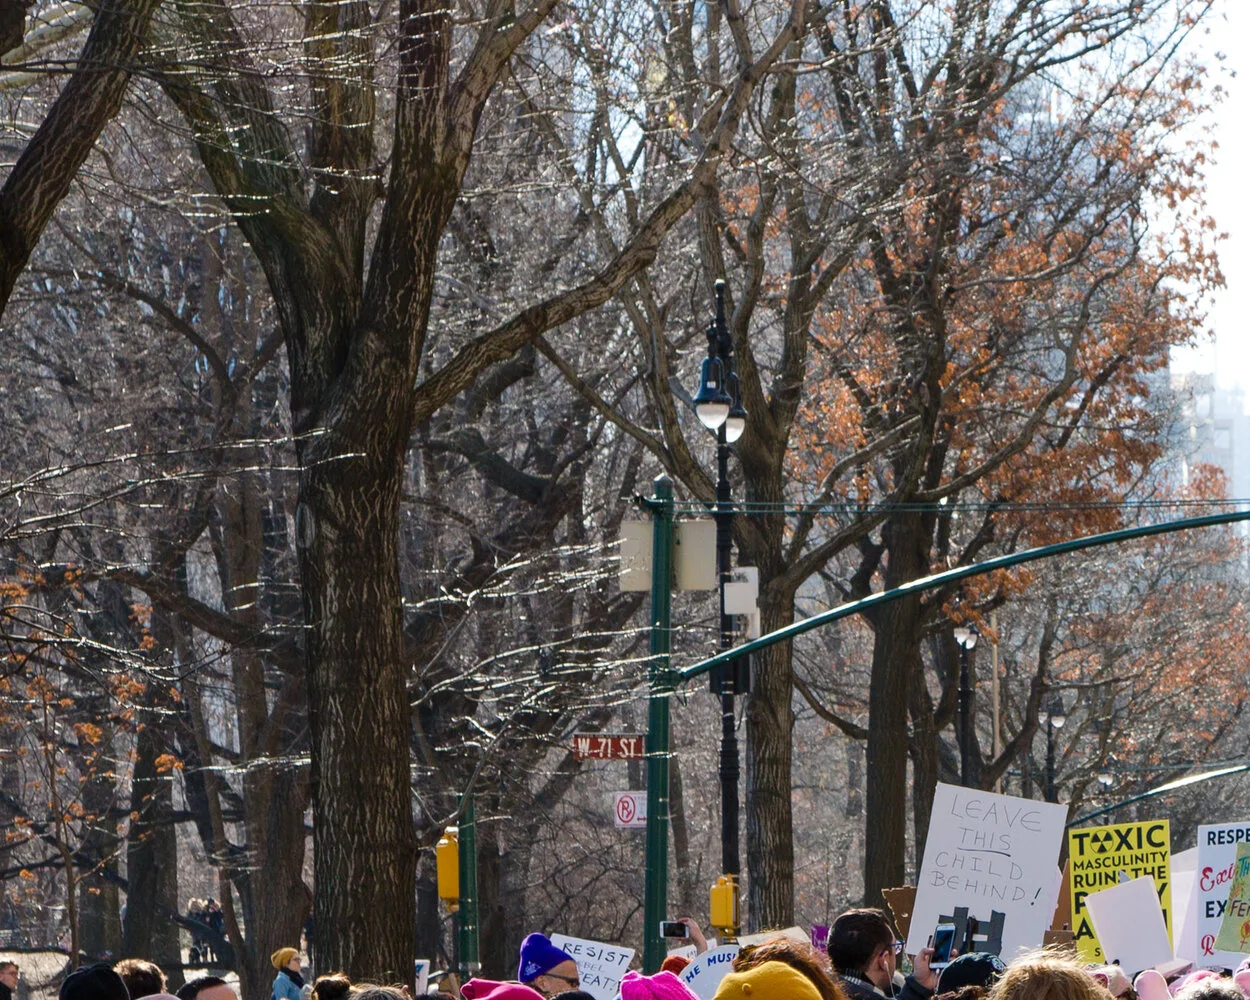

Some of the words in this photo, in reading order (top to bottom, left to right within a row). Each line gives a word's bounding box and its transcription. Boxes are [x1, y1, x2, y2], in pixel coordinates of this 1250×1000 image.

[577, 737, 590, 758] W
[597, 738, 612, 758] 71
[620, 738, 637, 758] ST
[951, 793, 1042, 832] LEAVE
[958, 827, 1011, 851] THIS
[935, 851, 1023, 881] CHILD
[1073, 851, 1168, 871] MASCULINITY
[1131, 865, 1167, 881] THE
[930, 870, 1042, 906] BEHIND!
[1205, 899, 1228, 918] EX
[562, 942, 629, 966] RESIST
[685, 965, 702, 985] HE
